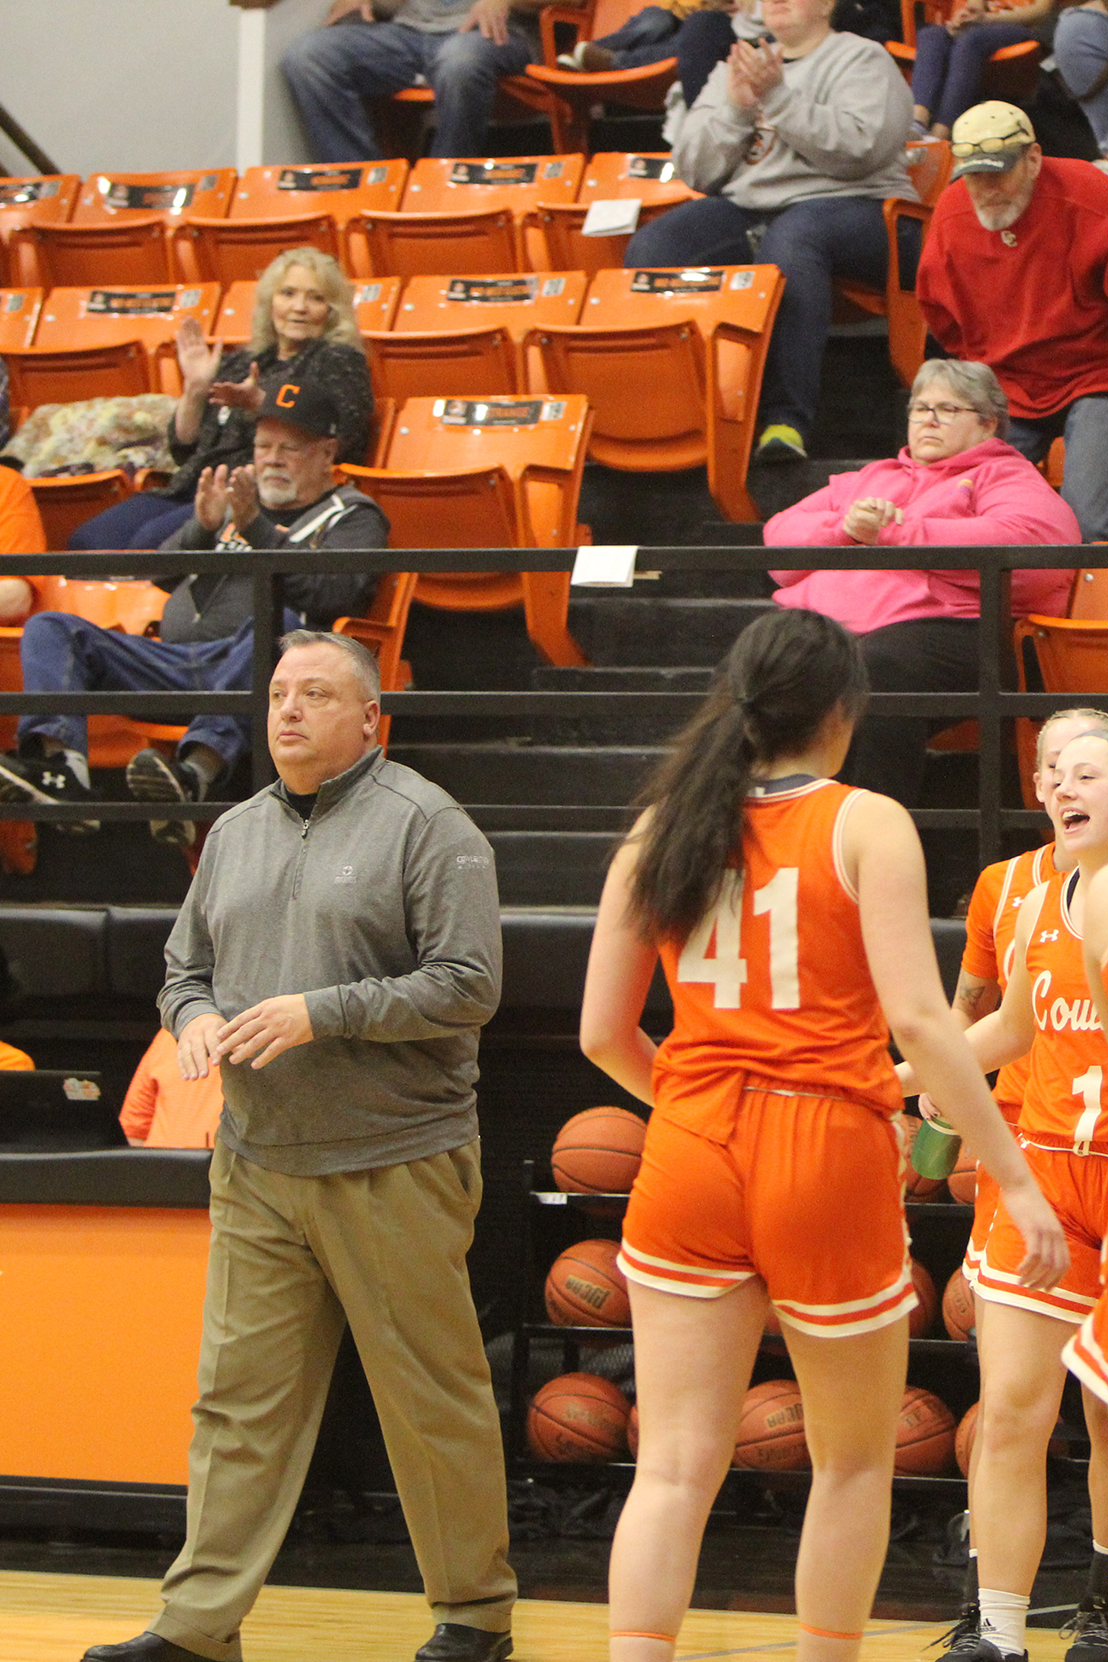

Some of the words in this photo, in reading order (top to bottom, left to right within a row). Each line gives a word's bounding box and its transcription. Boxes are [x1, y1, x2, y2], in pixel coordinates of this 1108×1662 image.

[275, 383, 301, 408] C
[677, 867, 801, 1009] 41
[1032, 969, 1104, 1032] Cow
[1071, 1065, 1103, 1142] 1
